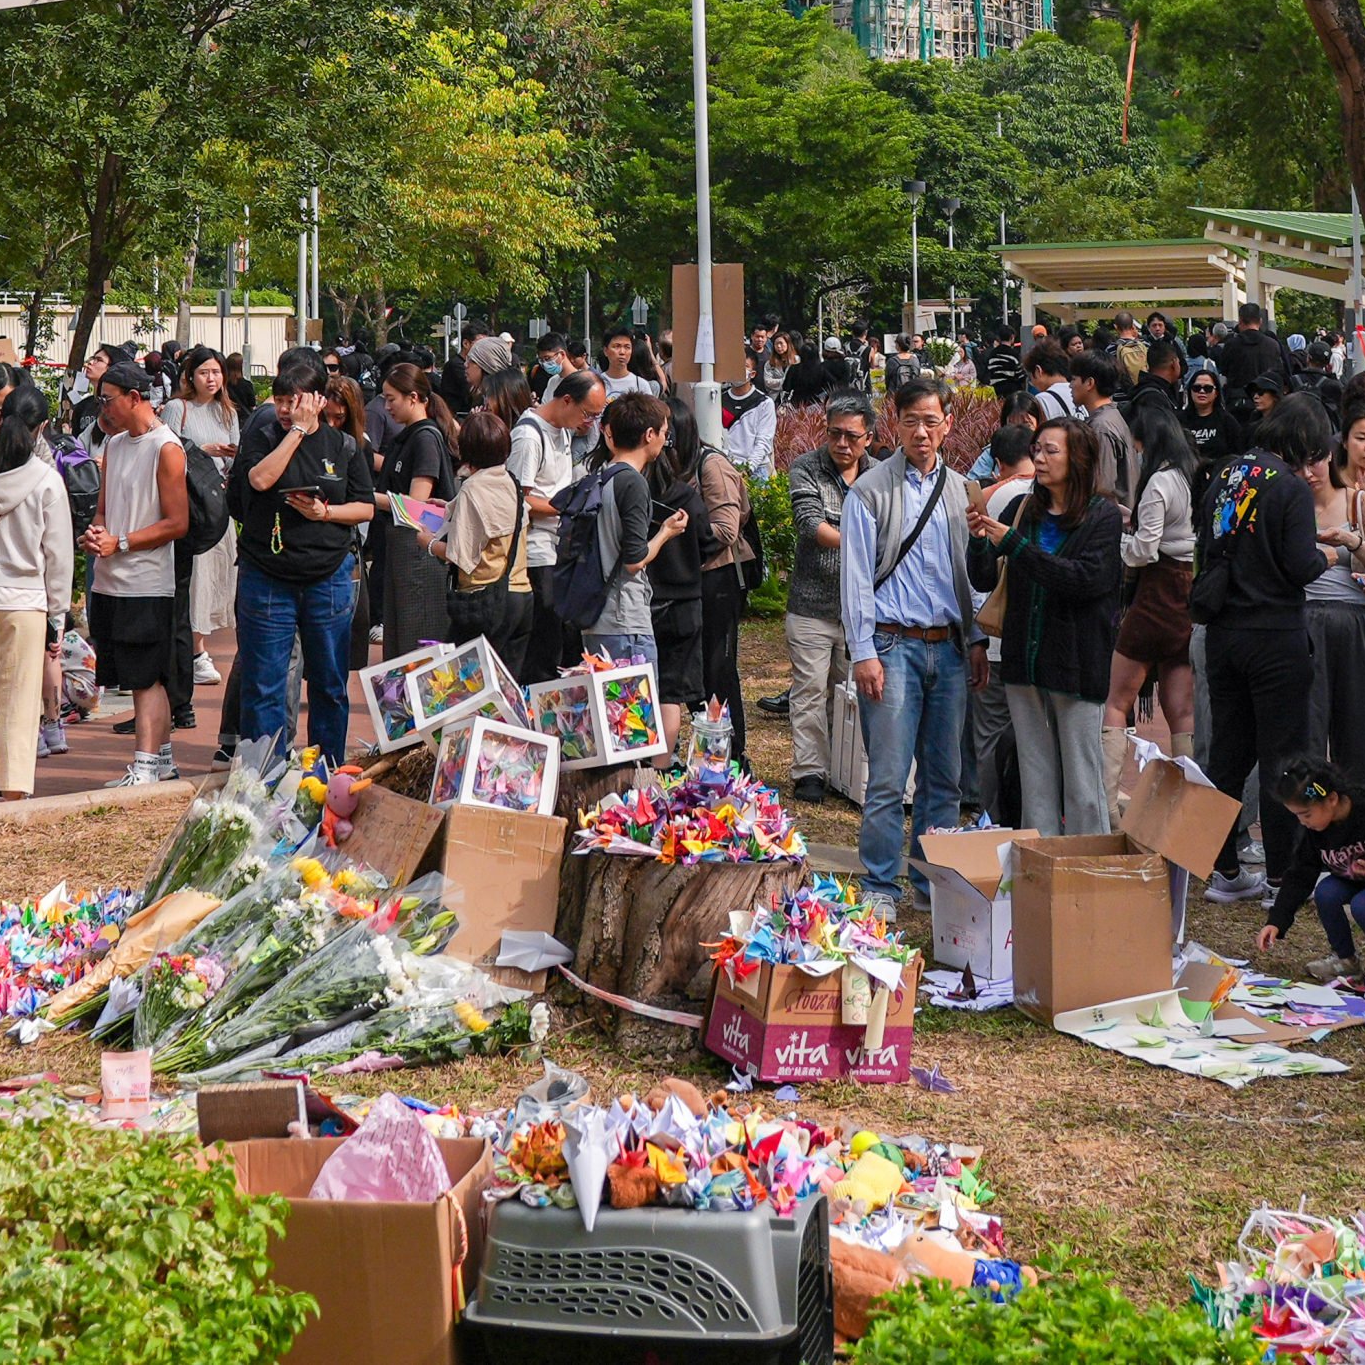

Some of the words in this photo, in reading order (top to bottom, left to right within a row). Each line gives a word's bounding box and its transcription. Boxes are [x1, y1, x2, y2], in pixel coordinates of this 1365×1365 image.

[1220, 464, 1278, 480] CURRY
[795, 993, 829, 1012] 100%
[723, 1014, 749, 1055] vita
[775, 1031, 829, 1066] vita
[845, 1037, 899, 1067] vita
